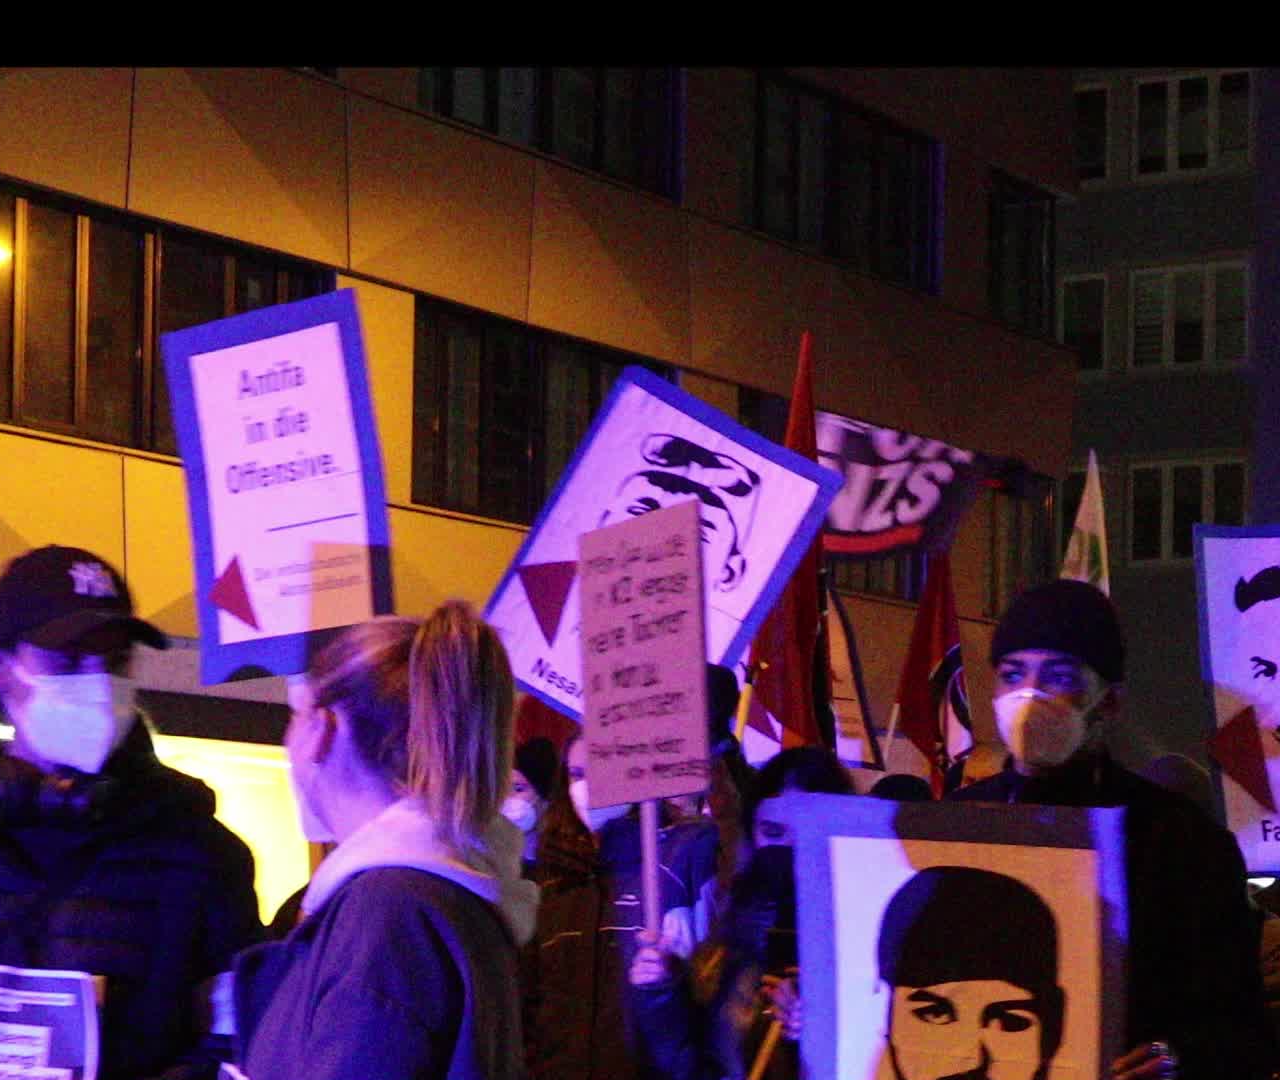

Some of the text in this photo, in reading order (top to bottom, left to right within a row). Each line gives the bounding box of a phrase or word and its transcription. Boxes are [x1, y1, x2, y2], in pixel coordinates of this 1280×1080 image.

[239, 361, 305, 398] Antifa
[244, 406, 310, 444] in die
[226, 450, 339, 493] Offensive.
